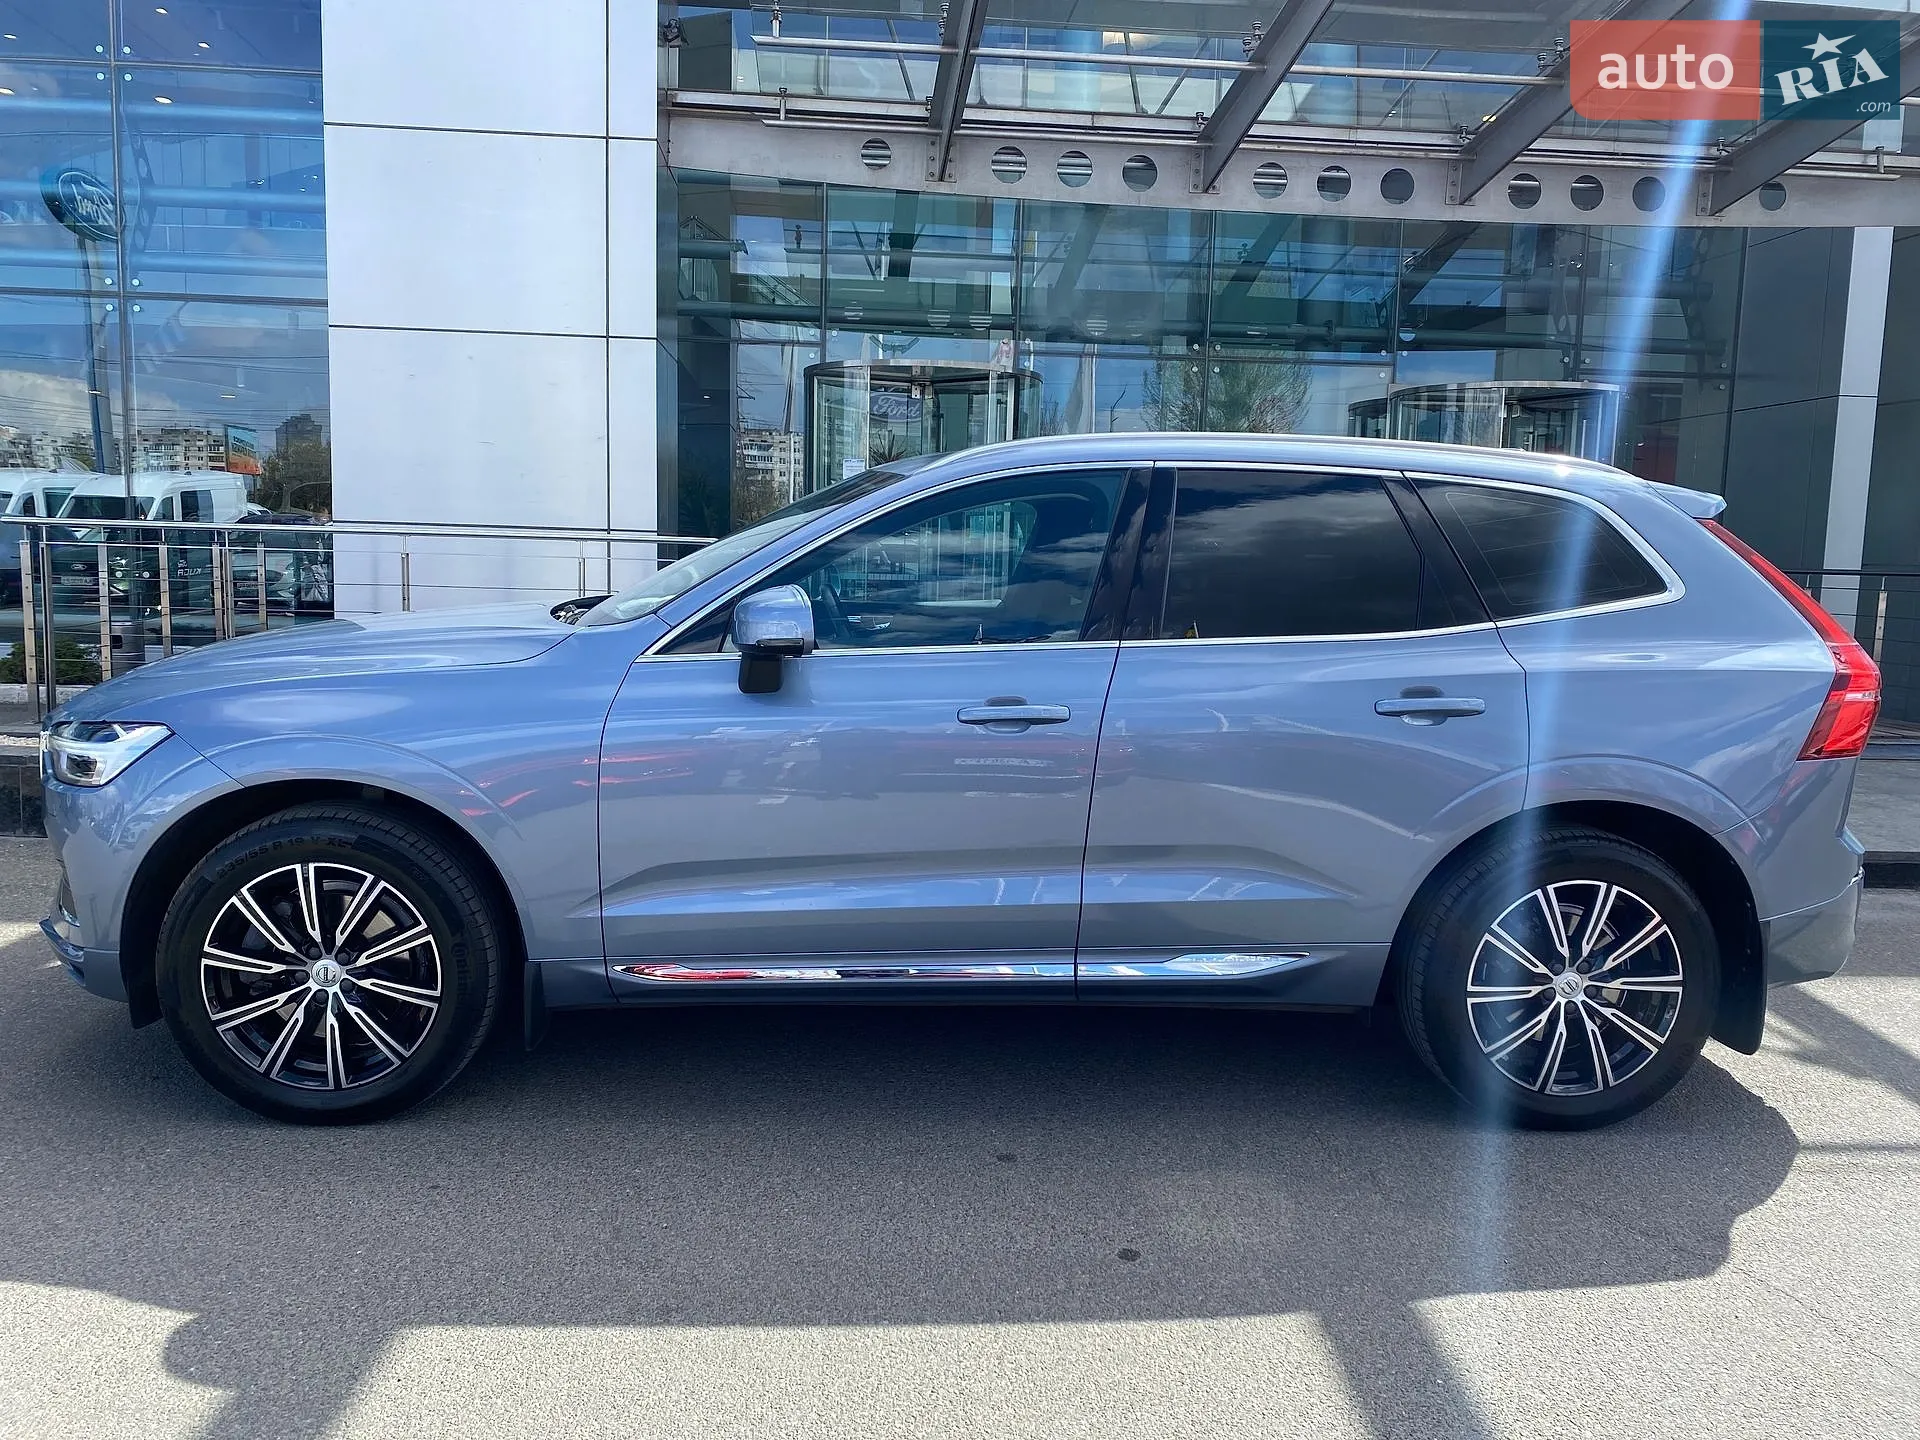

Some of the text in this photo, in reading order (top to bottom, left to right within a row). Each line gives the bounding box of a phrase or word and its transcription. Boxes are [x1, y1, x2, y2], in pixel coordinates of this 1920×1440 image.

[873, 395, 920, 416] Ford
[216, 844, 269, 879] 235/55
[272, 840, 283, 850] R
